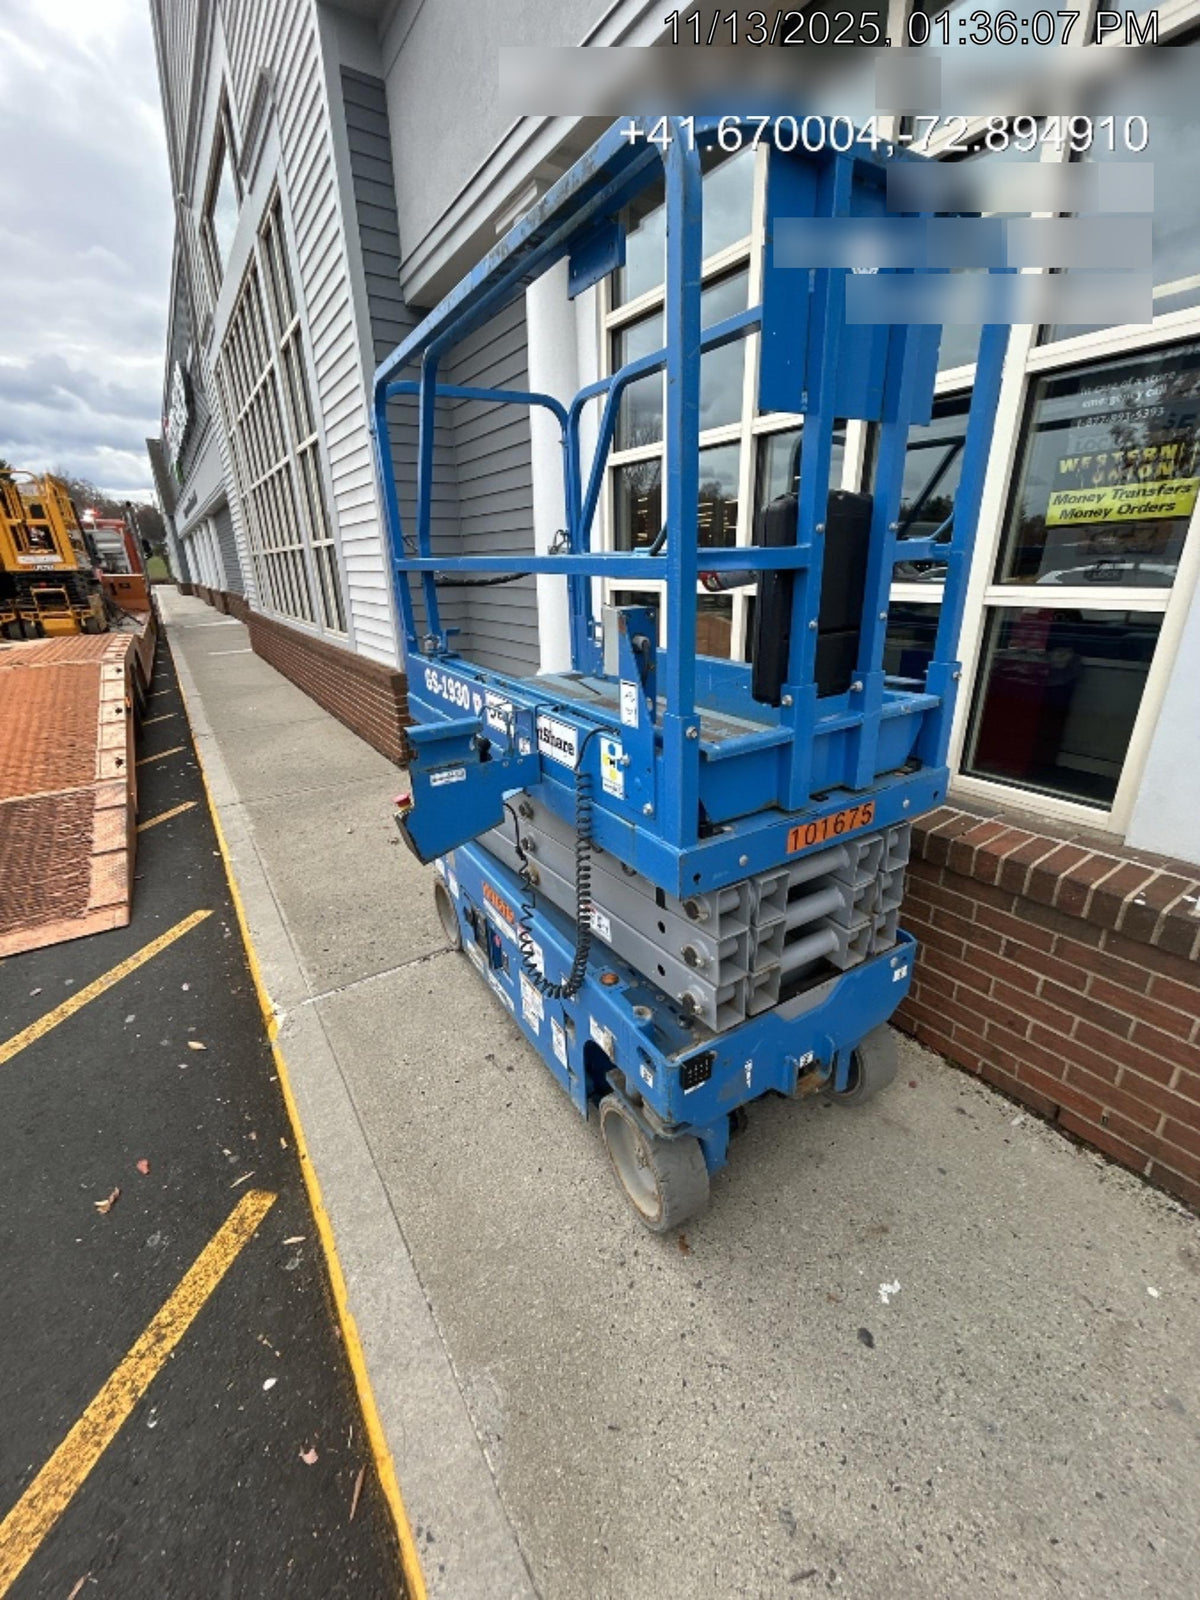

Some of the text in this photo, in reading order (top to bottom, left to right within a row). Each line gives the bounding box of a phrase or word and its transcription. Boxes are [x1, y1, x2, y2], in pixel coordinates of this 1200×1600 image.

[1053, 483, 1193, 506] Money Transfers
[1059, 502, 1176, 520] Money Orders
[424, 668, 470, 711] GS-1930
[791, 802, 872, 850] 101675
